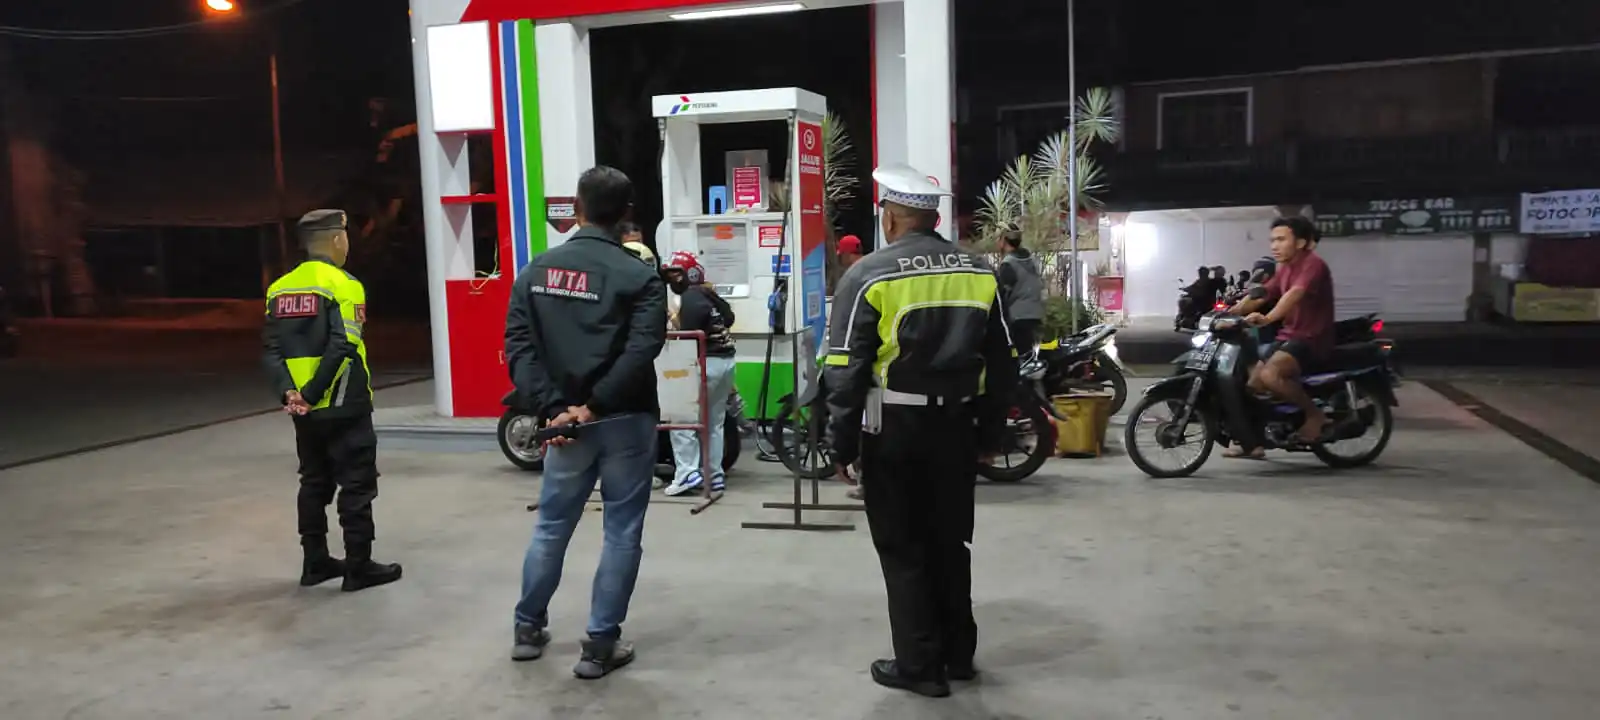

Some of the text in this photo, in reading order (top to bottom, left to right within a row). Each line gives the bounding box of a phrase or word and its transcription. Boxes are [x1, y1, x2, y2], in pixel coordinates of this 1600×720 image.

[897, 254, 973, 272] POLICE
[547, 269, 588, 291] WTA
[278, 295, 315, 314] POLISI
